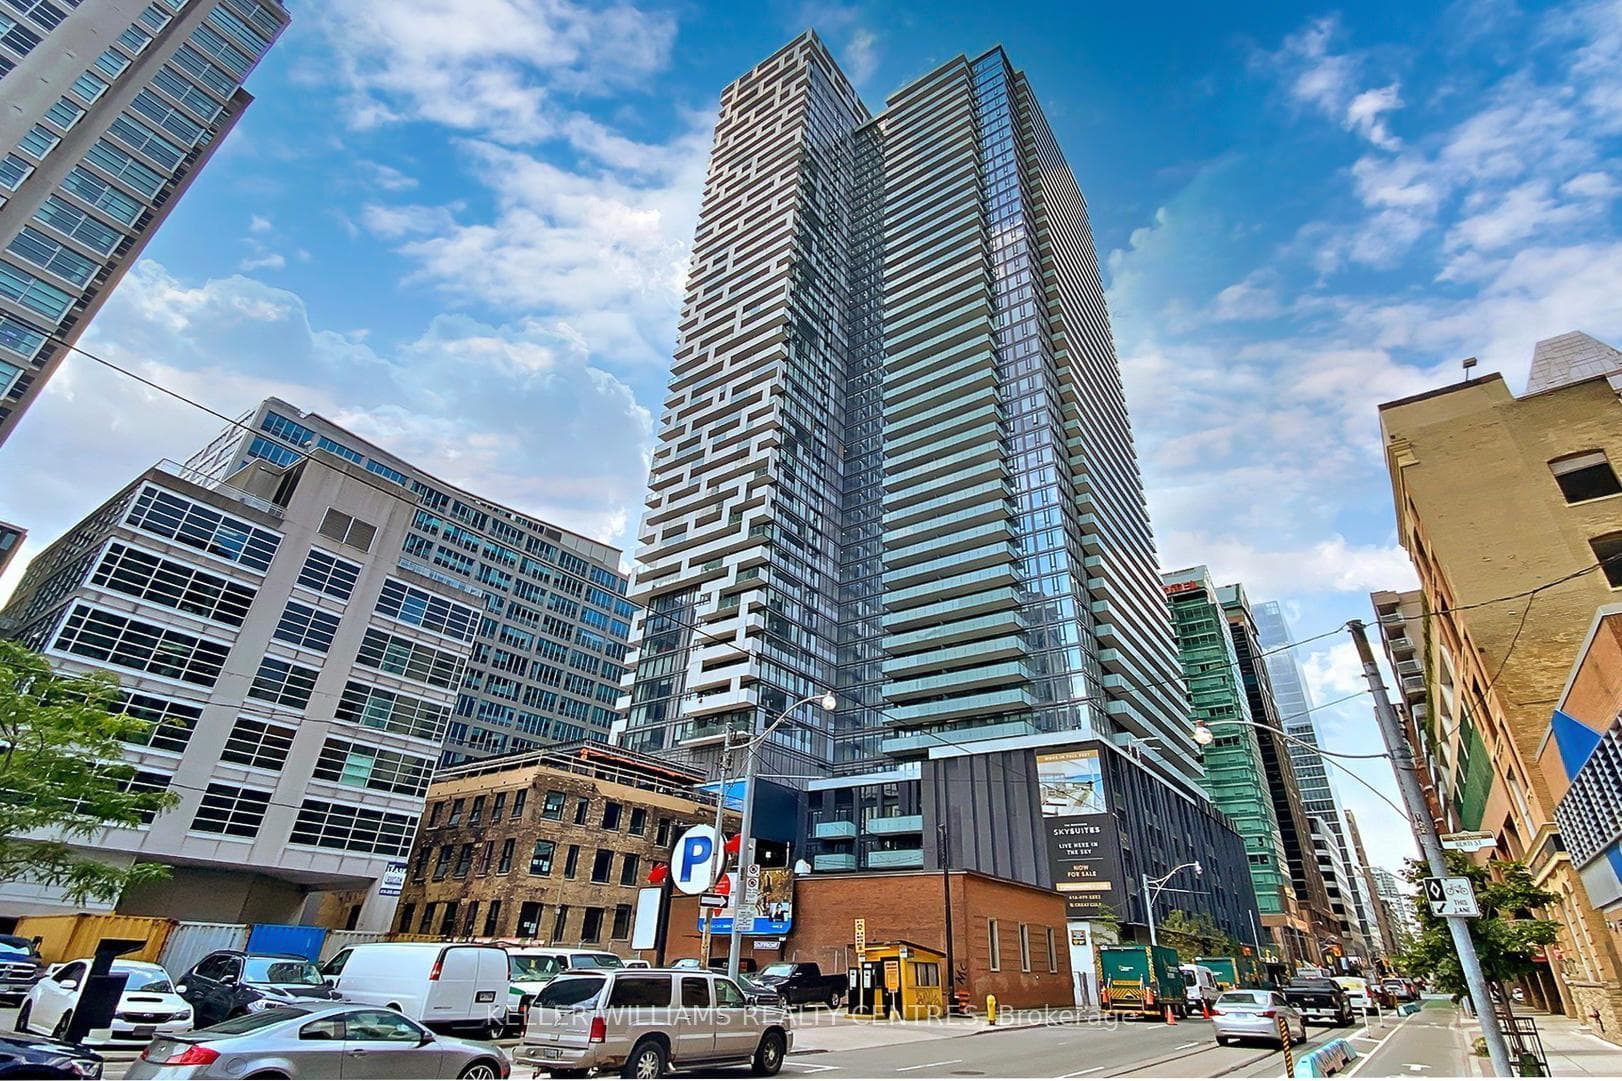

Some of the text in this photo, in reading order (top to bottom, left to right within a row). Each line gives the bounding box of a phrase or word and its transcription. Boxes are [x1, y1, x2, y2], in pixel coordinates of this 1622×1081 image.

[1053, 826, 1101, 836] SKYSUITES
[680, 835, 712, 883] P
[1455, 906, 1471, 914] LANE
